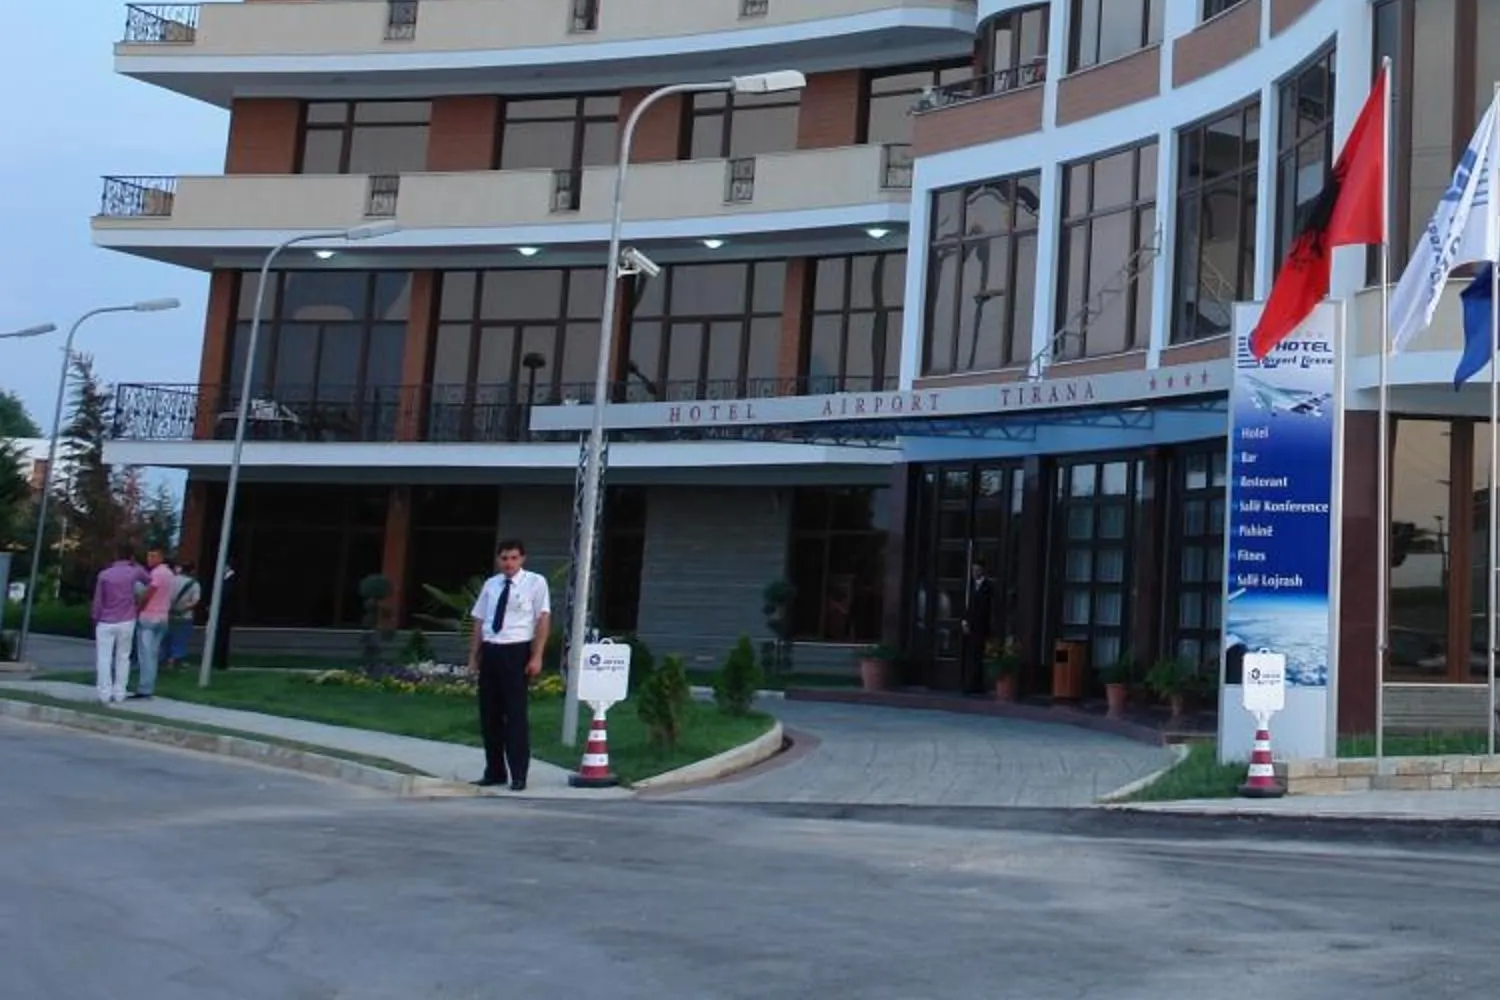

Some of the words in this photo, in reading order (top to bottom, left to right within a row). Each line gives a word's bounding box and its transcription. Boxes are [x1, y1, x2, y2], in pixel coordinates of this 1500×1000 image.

[669, 404, 757, 423] HOTEL
[822, 394, 939, 416] AIRPORT
[1001, 381, 1095, 406] TIRANA
[1241, 426, 1269, 439] Hotel
[1241, 452, 1257, 463] Bar
[1264, 499, 1328, 513] Konference
